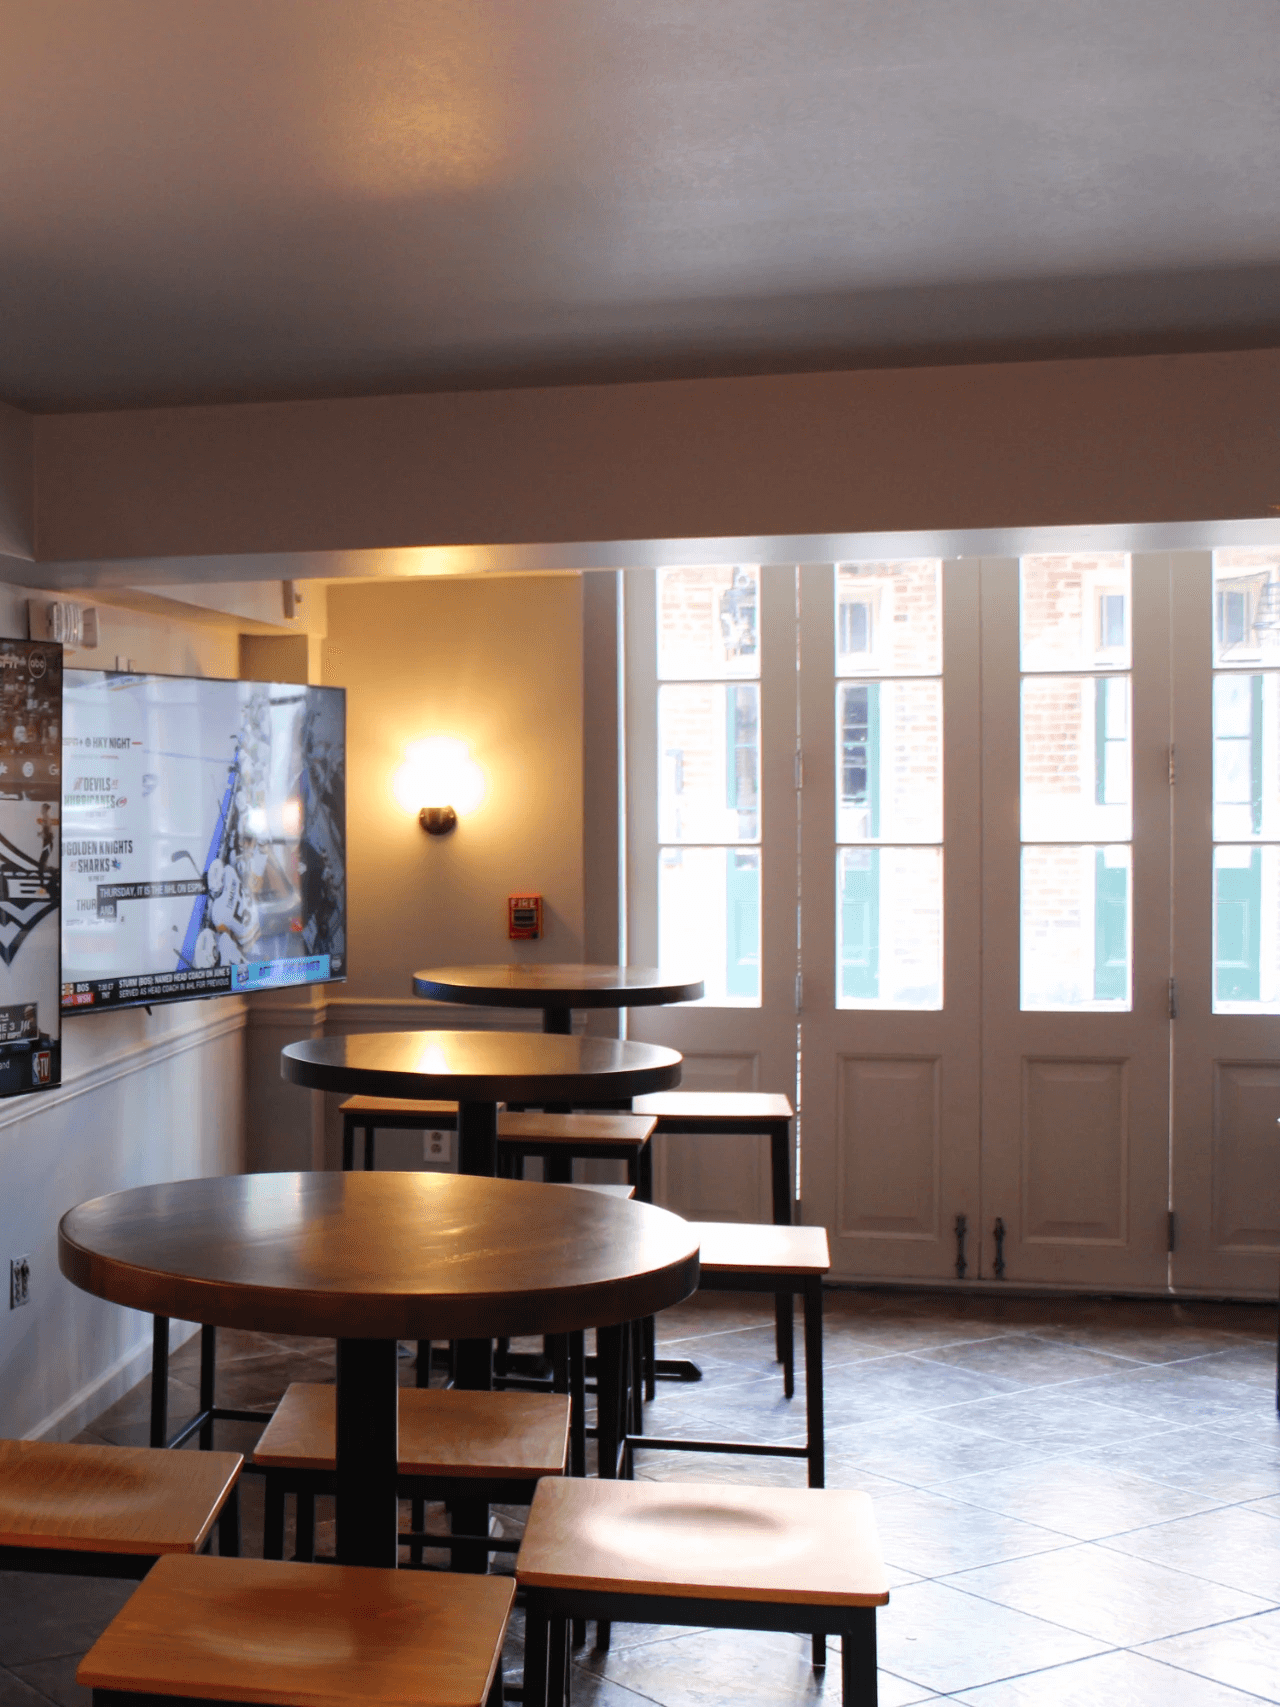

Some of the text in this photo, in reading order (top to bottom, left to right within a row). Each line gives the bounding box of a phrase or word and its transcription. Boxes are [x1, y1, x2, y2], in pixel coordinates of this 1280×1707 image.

[109, 737, 131, 749] NIGHT
[83, 777, 111, 792] DEVILS
[66, 840, 133, 856] GOLDEN KNIGHTS
[78, 858, 110, 873] SHARKS
[9, 1022, 16, 1031] 3
